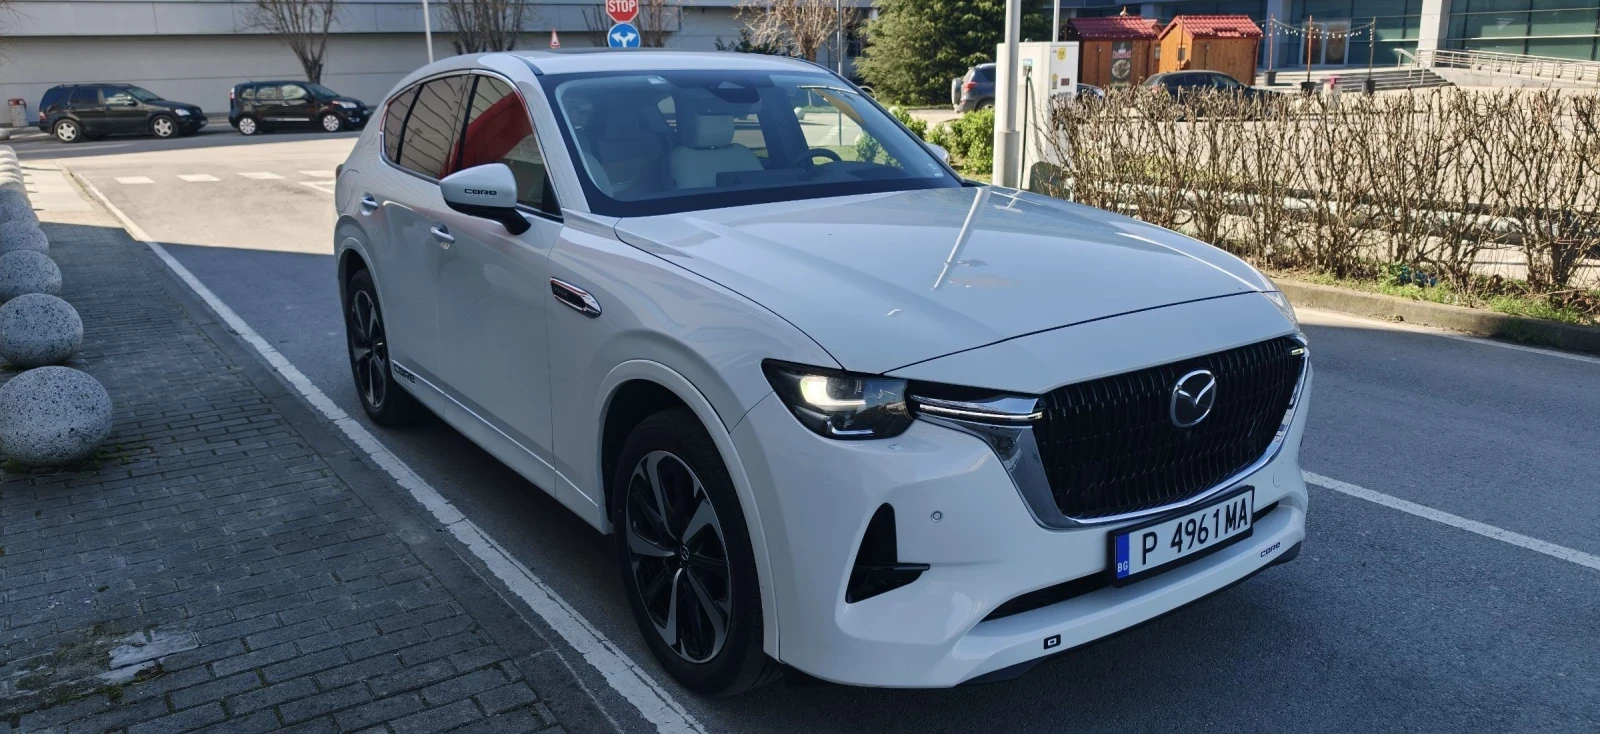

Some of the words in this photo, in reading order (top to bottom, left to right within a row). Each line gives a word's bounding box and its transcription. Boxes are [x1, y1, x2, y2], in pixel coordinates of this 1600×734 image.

[609, 0, 635, 12] STOP
[1142, 531, 1158, 565] P
[1117, 560, 1129, 573] BG
